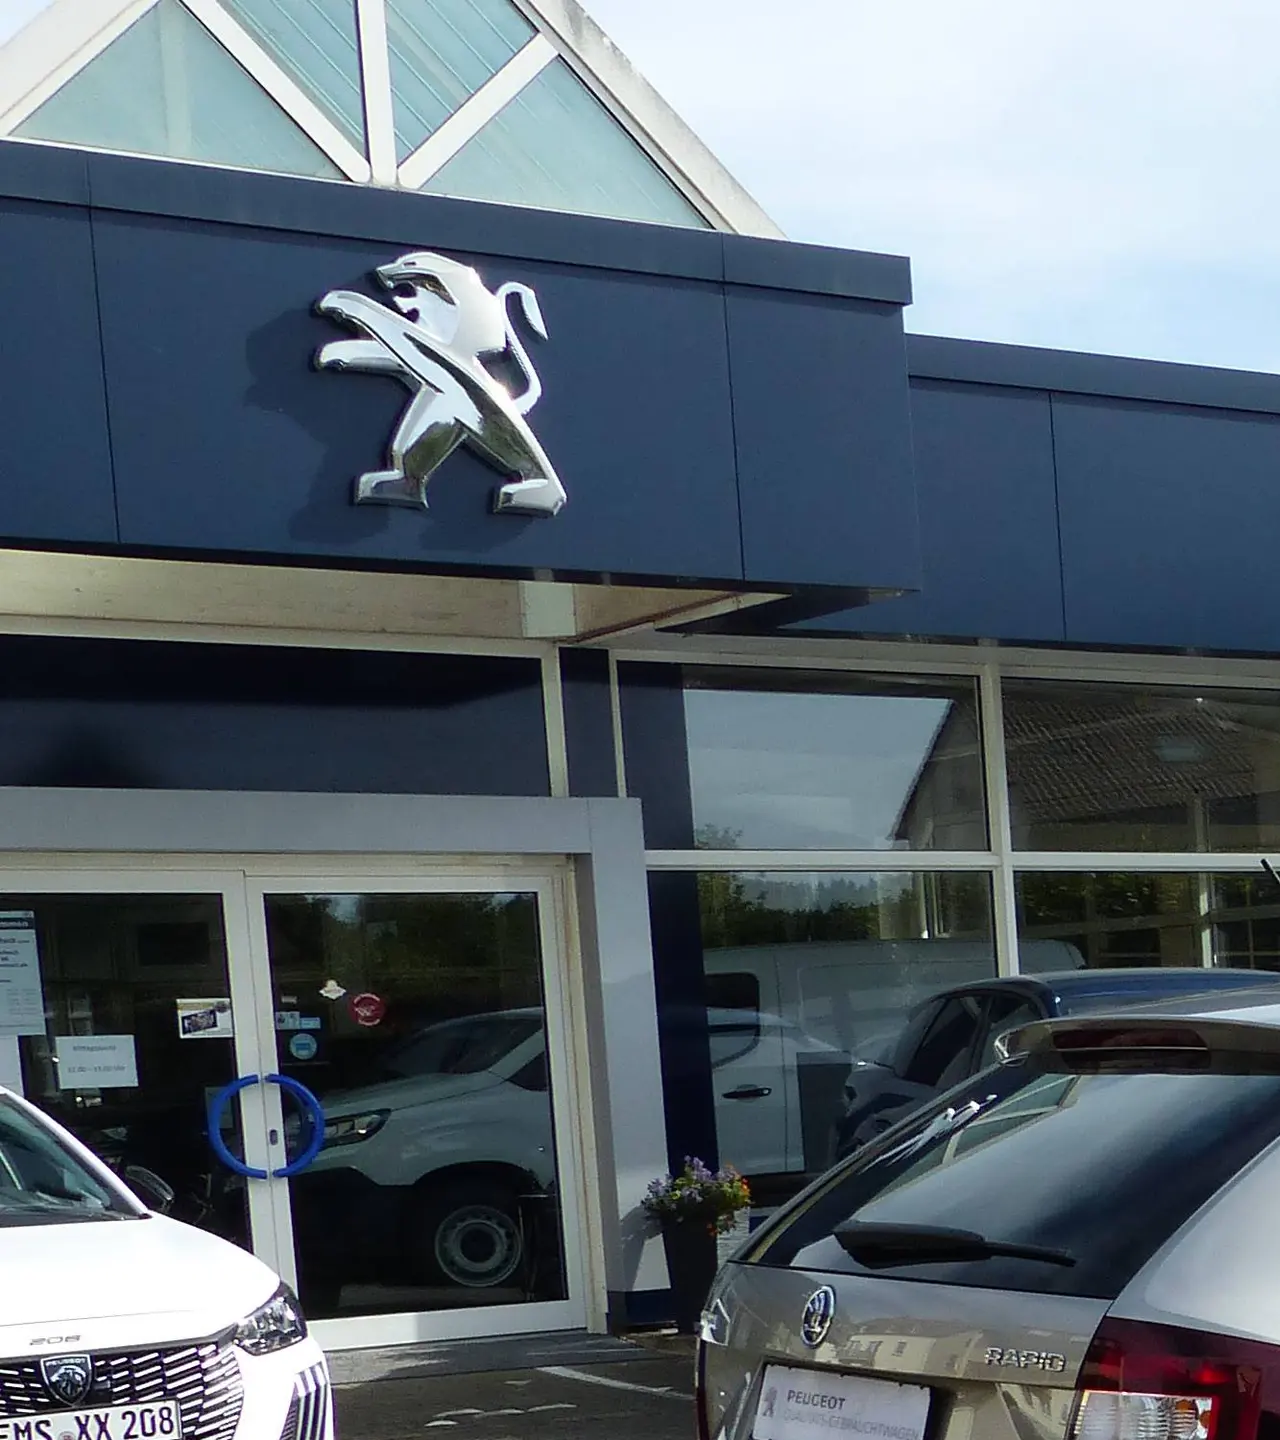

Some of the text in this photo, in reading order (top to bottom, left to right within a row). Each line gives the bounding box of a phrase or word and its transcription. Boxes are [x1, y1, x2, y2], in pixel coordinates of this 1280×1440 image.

[29, 1334, 82, 1346] 208
[983, 1346, 1066, 1373] RAPID
[786, 1389, 846, 1411] PEUGEOT
[121, 1406, 174, 1440] 208
